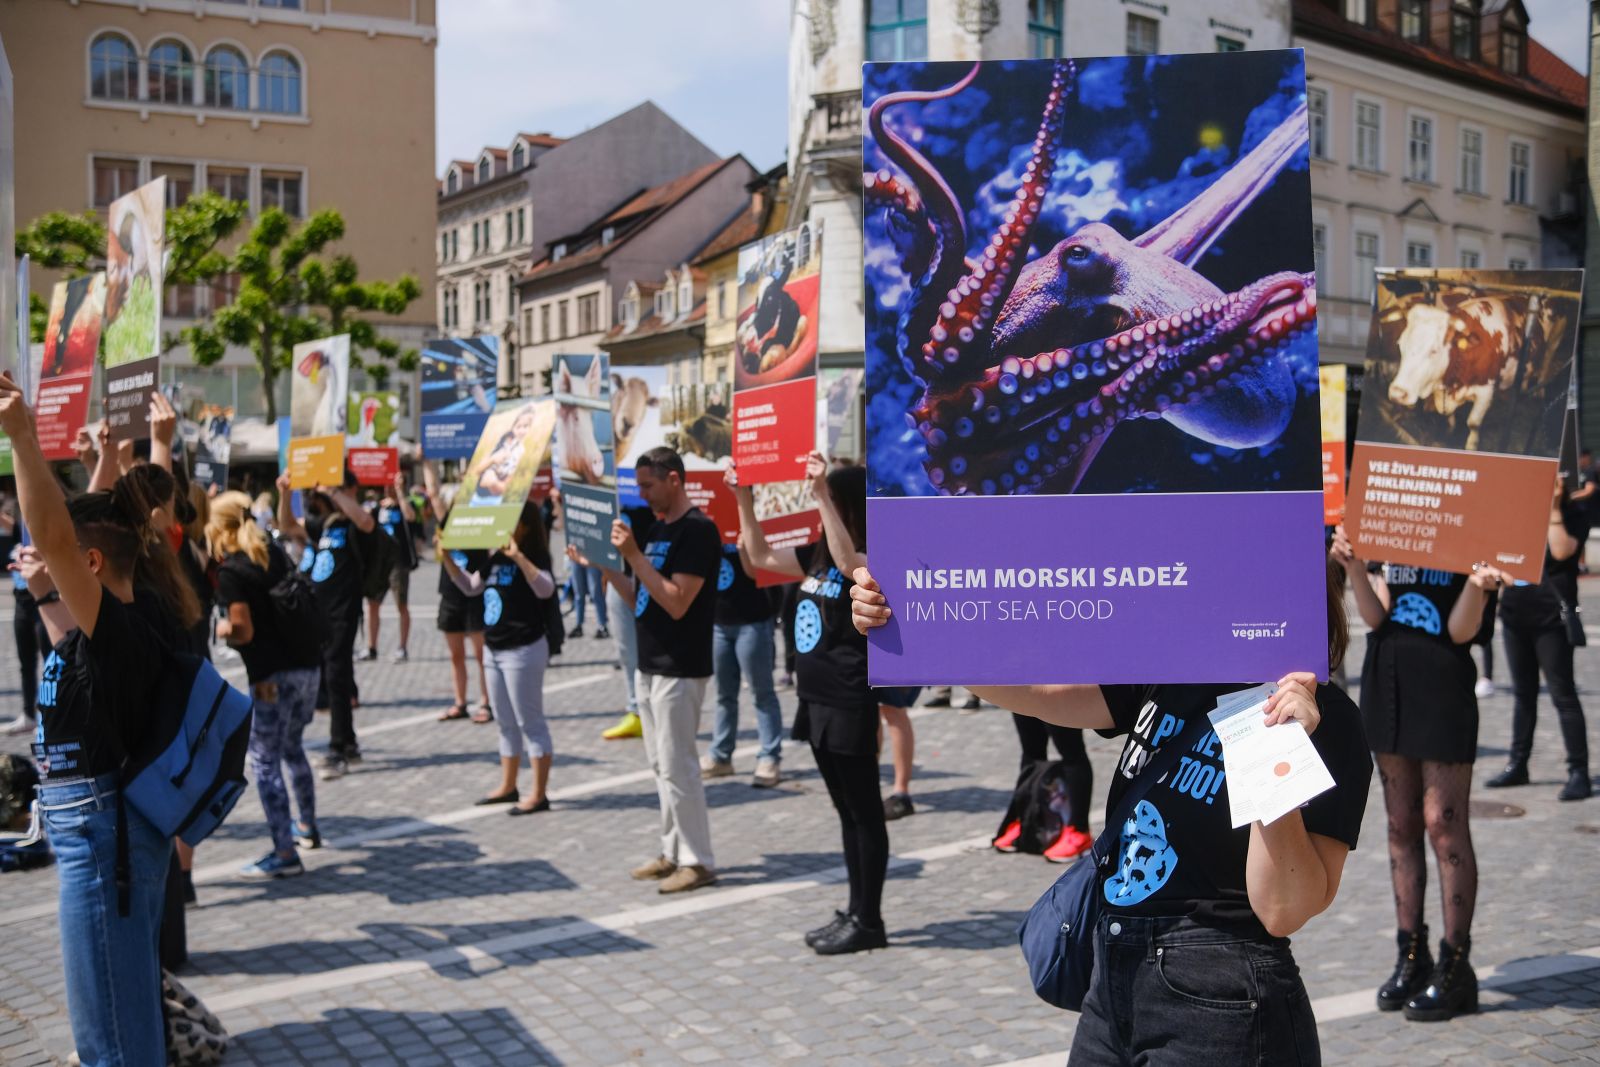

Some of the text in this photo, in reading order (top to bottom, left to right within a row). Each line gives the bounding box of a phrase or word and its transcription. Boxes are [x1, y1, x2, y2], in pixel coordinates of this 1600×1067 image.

[1369, 460, 1477, 482] VSE ŽIVLJENJE SEM
[1367, 475, 1462, 496] PRIKLENJENA NA
[1365, 490, 1441, 509] ISTEM MESTU
[1378, 505, 1424, 521] CHAINED
[1425, 511, 1441, 524] ON
[1443, 512, 1464, 527] THE
[1360, 518, 1438, 538] SAME SPOT FOR
[1358, 533, 1434, 553] MY WHOLE LIFE
[906, 562, 1188, 589] NISEM MORSKI SADEŽ
[906, 599, 1113, 621] I'M NOT SEA FOOD
[1231, 629, 1285, 640] vegan.si
[1170, 756, 1225, 805] TOO!
